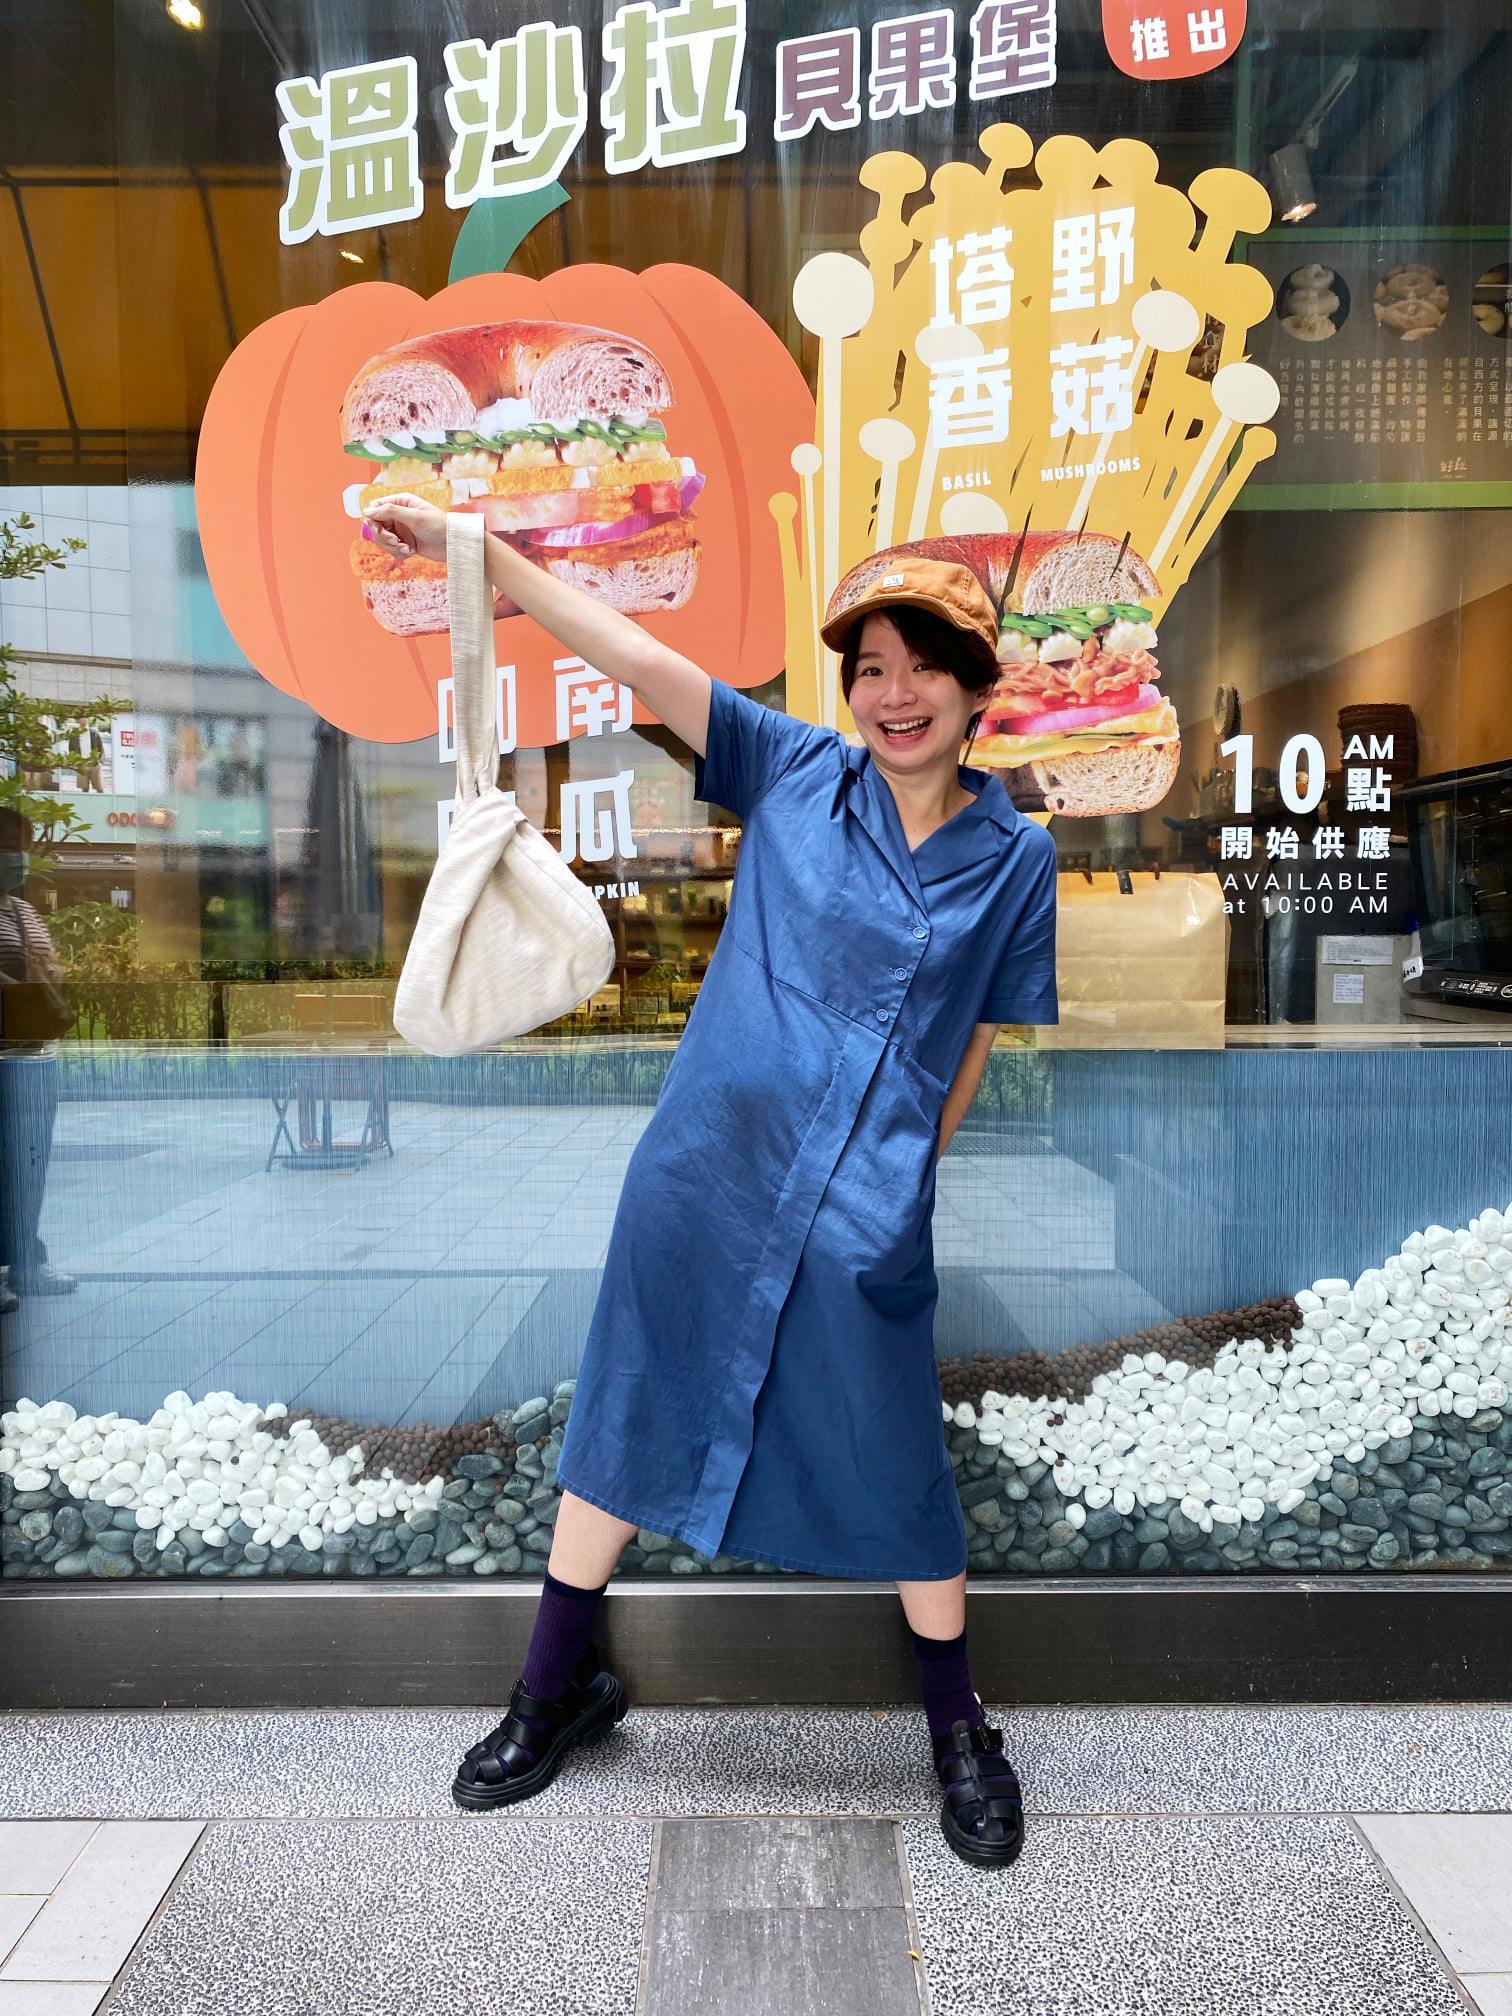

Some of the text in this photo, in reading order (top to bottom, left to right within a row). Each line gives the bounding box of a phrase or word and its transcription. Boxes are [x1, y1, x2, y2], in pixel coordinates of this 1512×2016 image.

[1129, 8, 1227, 63] 推出
[942, 471, 991, 491] BASIL
[1041, 456, 1141, 482] MUSHROOMS
[1343, 735, 1394, 760] AM
[1220, 734, 1392, 814] 10 點
[1220, 826, 1391, 860] 開始供應
[1223, 872, 1388, 891] AVAILABLE
[1222, 896, 1388, 914] at 10:00 AM
